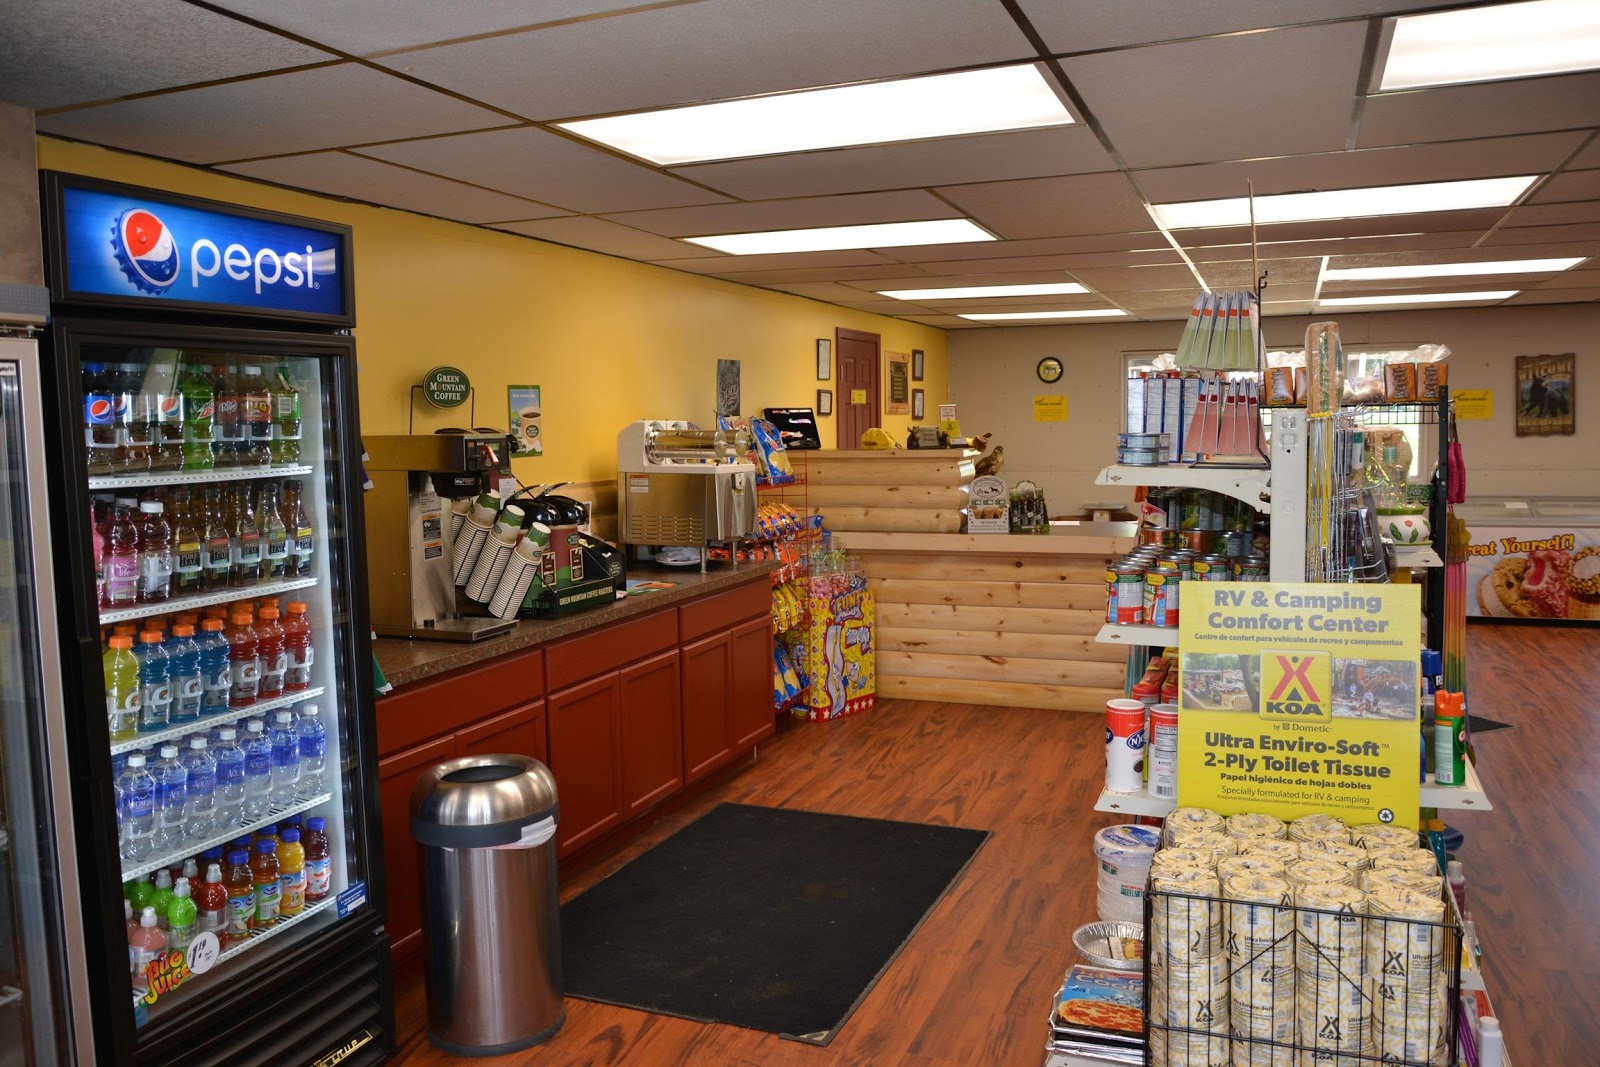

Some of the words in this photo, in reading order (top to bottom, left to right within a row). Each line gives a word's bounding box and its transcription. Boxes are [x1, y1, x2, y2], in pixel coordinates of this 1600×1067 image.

[191, 239, 313, 294] pepsi
[436, 374, 459, 382] GREEN
[430, 382, 466, 391] MOUNTAIN
[434, 391, 461, 400] COFFEE
[1467, 541, 1496, 556] reat
[1500, 534, 1575, 555] Yourself!
[587, 590, 599, 598] COFFEE
[1214, 590, 1246, 606] RV
[1250, 590, 1269, 607] &
[1274, 591, 1382, 613] Camping
[1208, 612, 1304, 631] Comfort
[1308, 614, 1389, 633] Center
[1229, 634, 1255, 642] confort
[1350, 638, 1404, 646] campamentos
[1266, 701, 1324, 716] KOA
[1273, 723, 1280, 731] by
[1292, 723, 1330, 732] Dometic
[1205, 731, 1255, 749] Ultra
[1204, 752, 1258, 773] 2-Ply
[1261, 755, 1320, 774] Toilet
[1323, 759, 1391, 779] Tissue
[1220, 772, 1247, 782] Papel
[1248, 773, 1294, 786] higiénico
[1294, 777, 1308, 786] de
[1309, 778, 1336, 788] hojas
[1337, 780, 1372, 790] dobles
[1221, 785, 1256, 797] Specially
[1257, 788, 1300, 799] formulated
[1301, 790, 1313, 800] for
[1314, 792, 1325, 800] RV
[1326, 793, 1333, 801] &
[1334, 793, 1370, 806] camping
[1381, 968, 1406, 977] KOA
[1318, 1032, 1343, 1041] KOA
